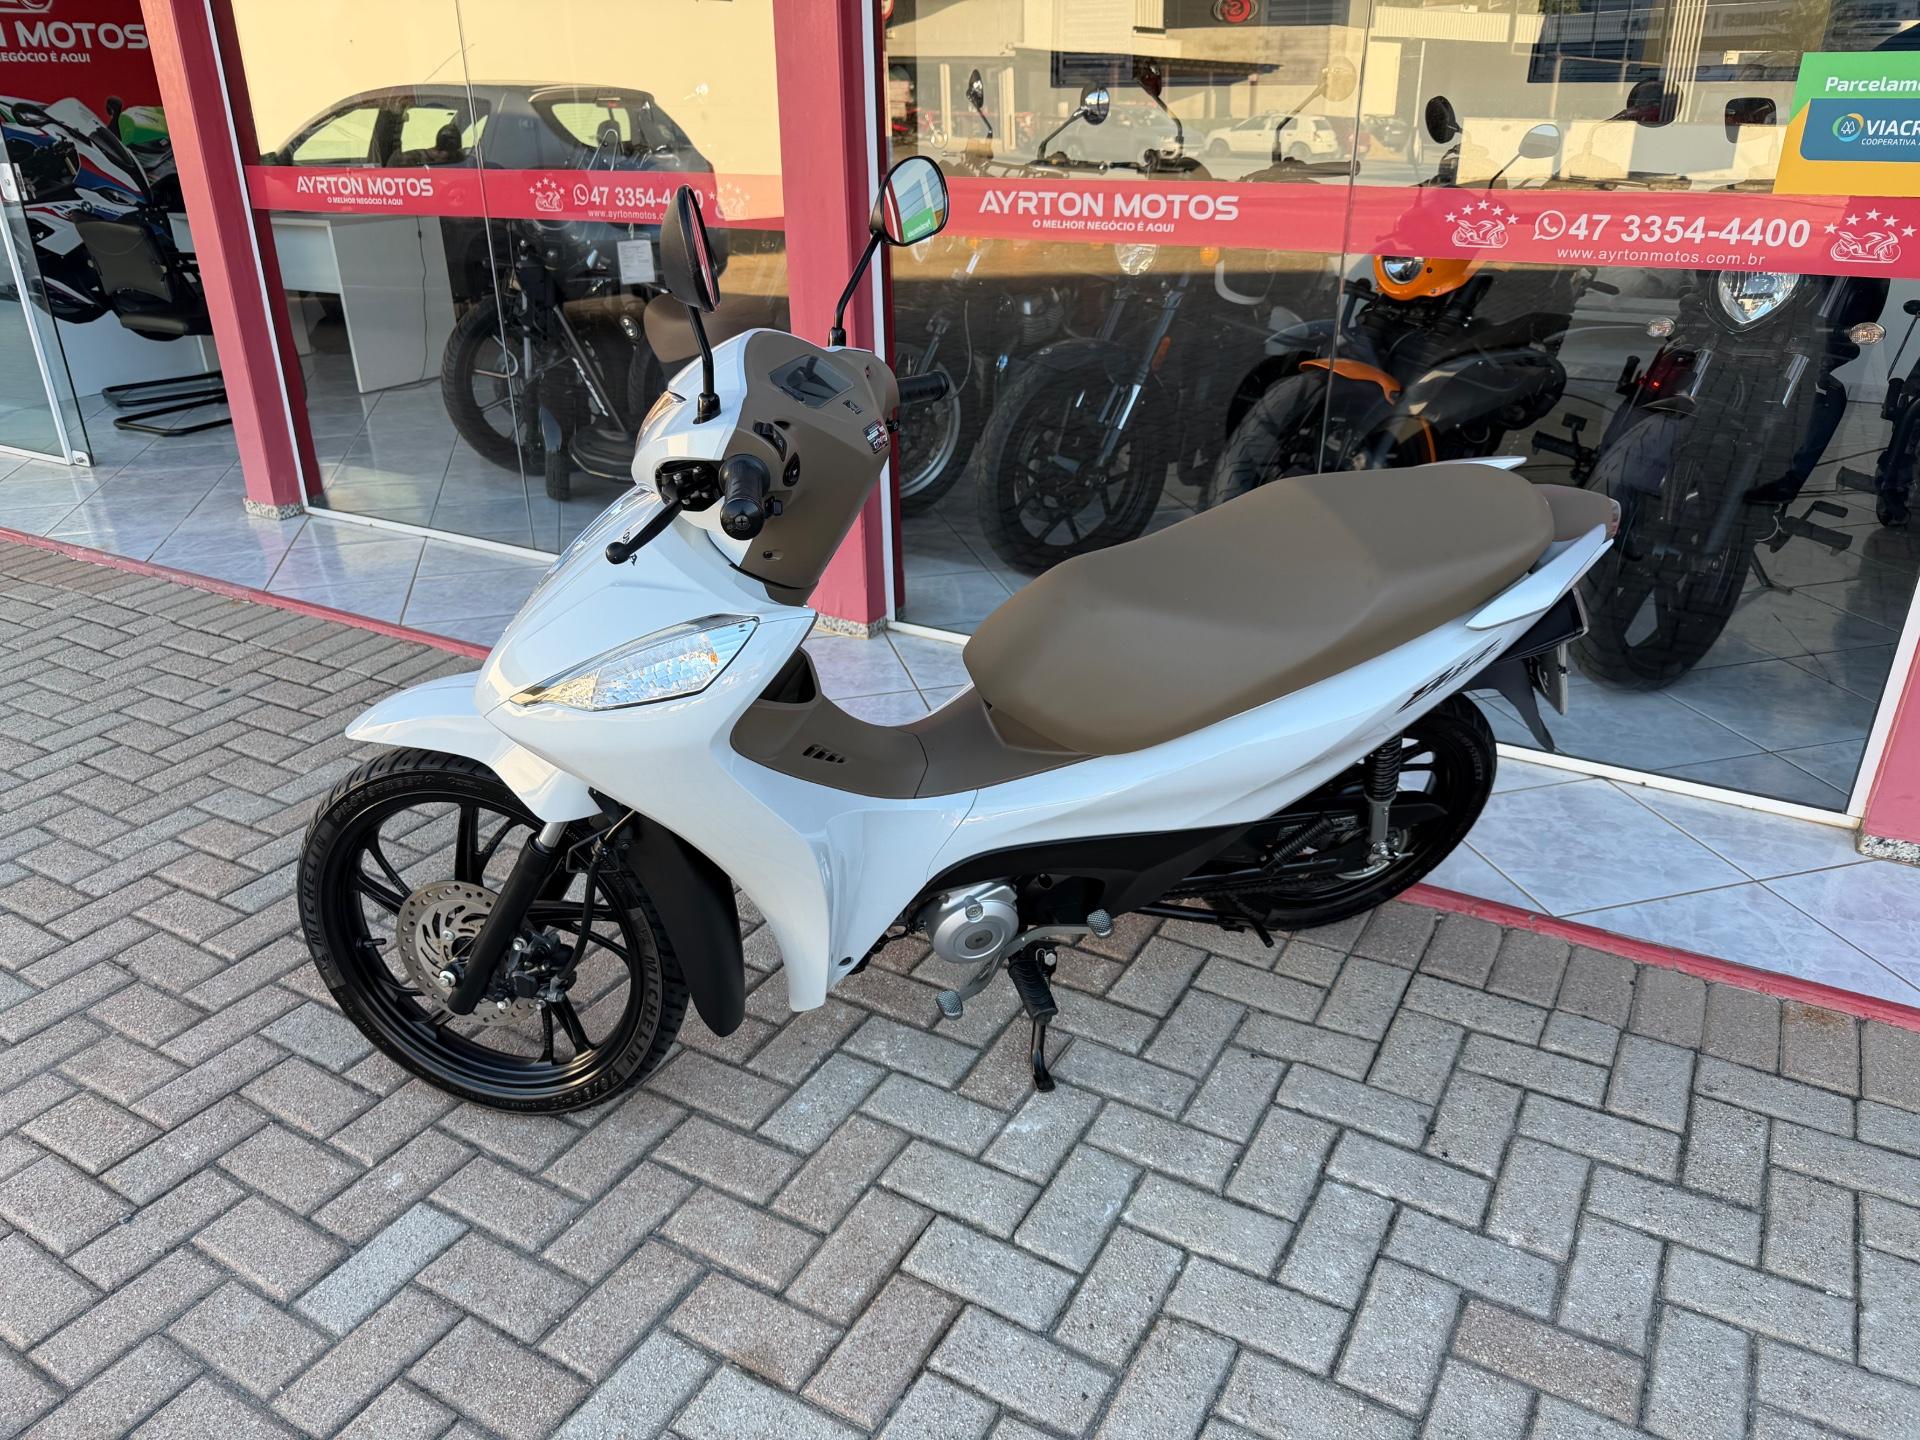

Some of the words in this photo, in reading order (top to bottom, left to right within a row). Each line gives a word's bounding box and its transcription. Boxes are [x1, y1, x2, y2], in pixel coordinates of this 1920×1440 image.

[14, 20, 149, 49] MOTOS
[0, 50, 49, 63] EGÓCIO
[60, 53, 91, 63] AQUI
[1861, 138, 1916, 146] COOPERATIVA
[297, 176, 363, 195] AYRTON
[368, 177, 433, 196] MOTOS
[590, 185, 609, 206] 47
[615, 187, 703, 209] 3354-40
[587, 208, 665, 220] www.ayrtonmotos.c
[978, 189, 1104, 218] AYRTON
[1114, 192, 1240, 221] MOTOS
[1032, 219, 1041, 229] O
[1042, 220, 1086, 230] MELHOR
[1087, 219, 1136, 232] NEGÓCIO
[1136, 220, 1145, 232] É
[1146, 222, 1176, 233] AQUI
[1568, 213, 1612, 242] 47
[1620, 215, 1811, 248] 3354-4400
[1556, 247, 1767, 267] www.ayrtonmotos.com.br
[303, 835, 328, 946] MICHELIN
[627, 954, 659, 1067] MICHELIN
